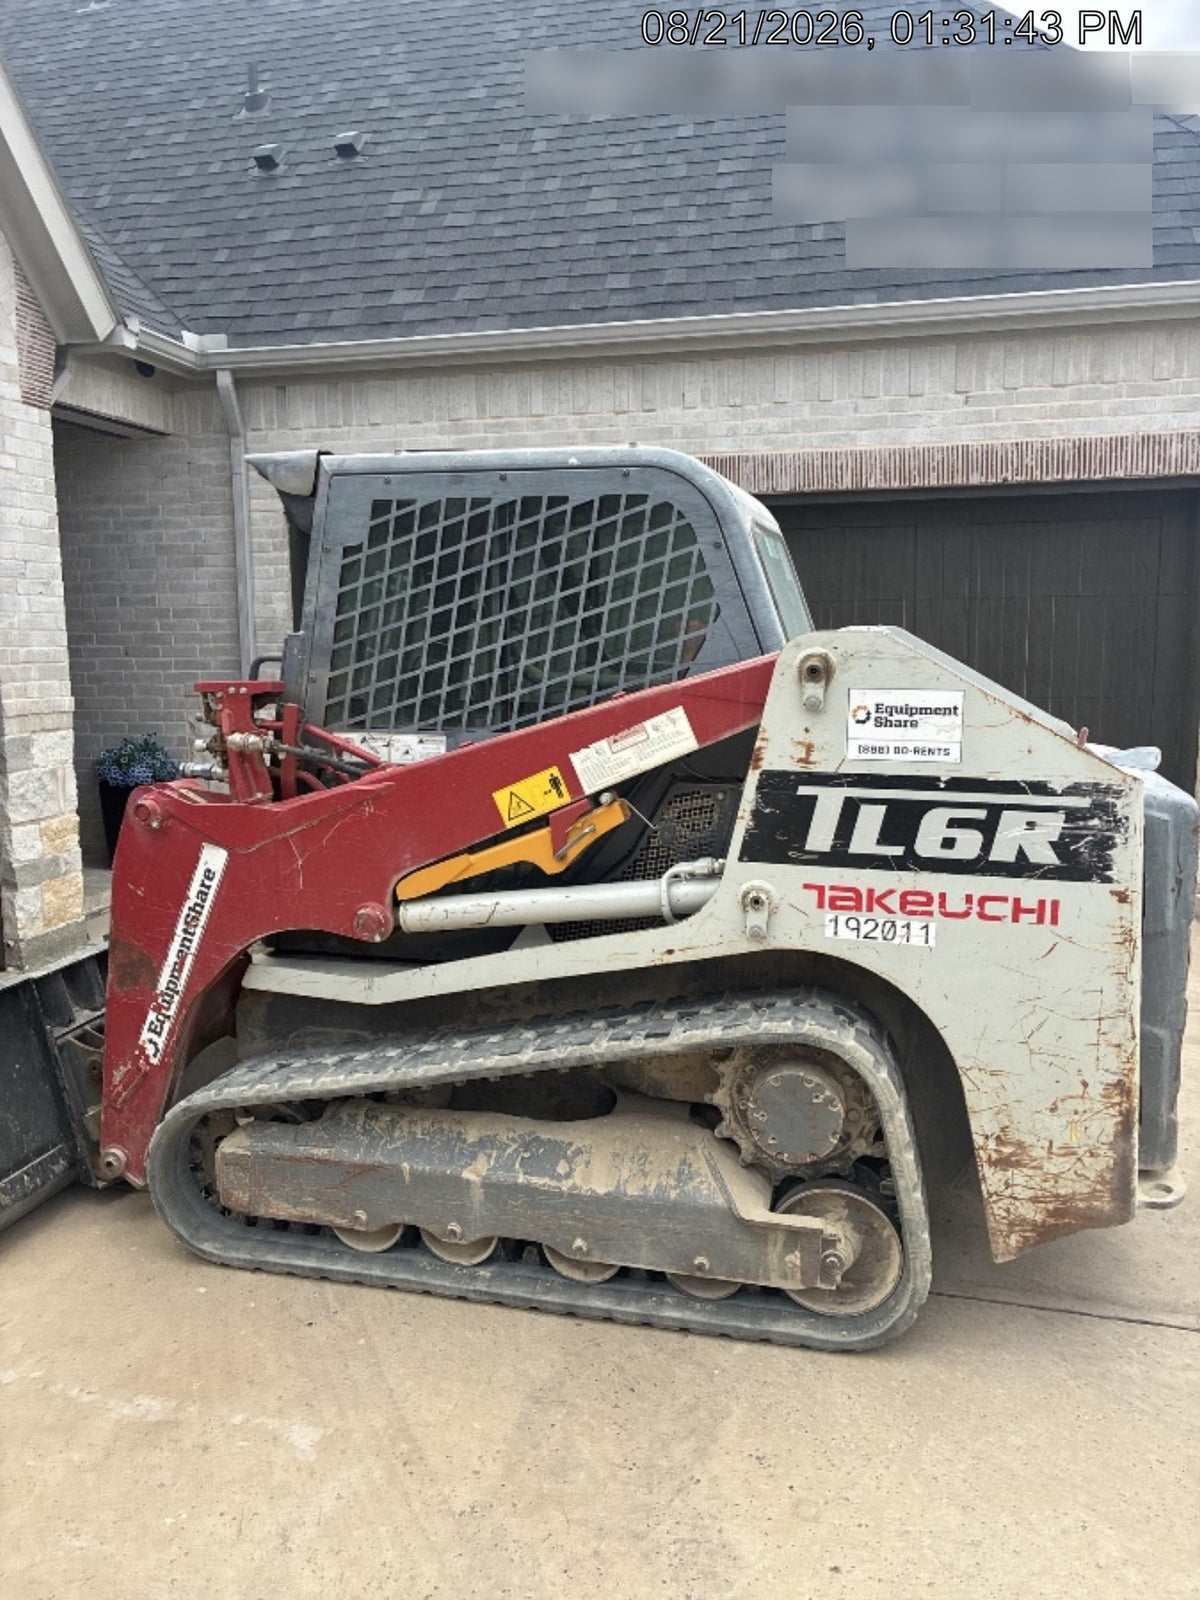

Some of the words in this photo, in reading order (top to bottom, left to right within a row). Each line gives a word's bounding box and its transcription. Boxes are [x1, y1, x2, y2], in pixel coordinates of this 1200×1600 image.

[874, 703, 959, 718] Equipment
[874, 716, 919, 728] Share
[797, 785, 1092, 865] TL6R
[828, 915, 930, 945] 192011
